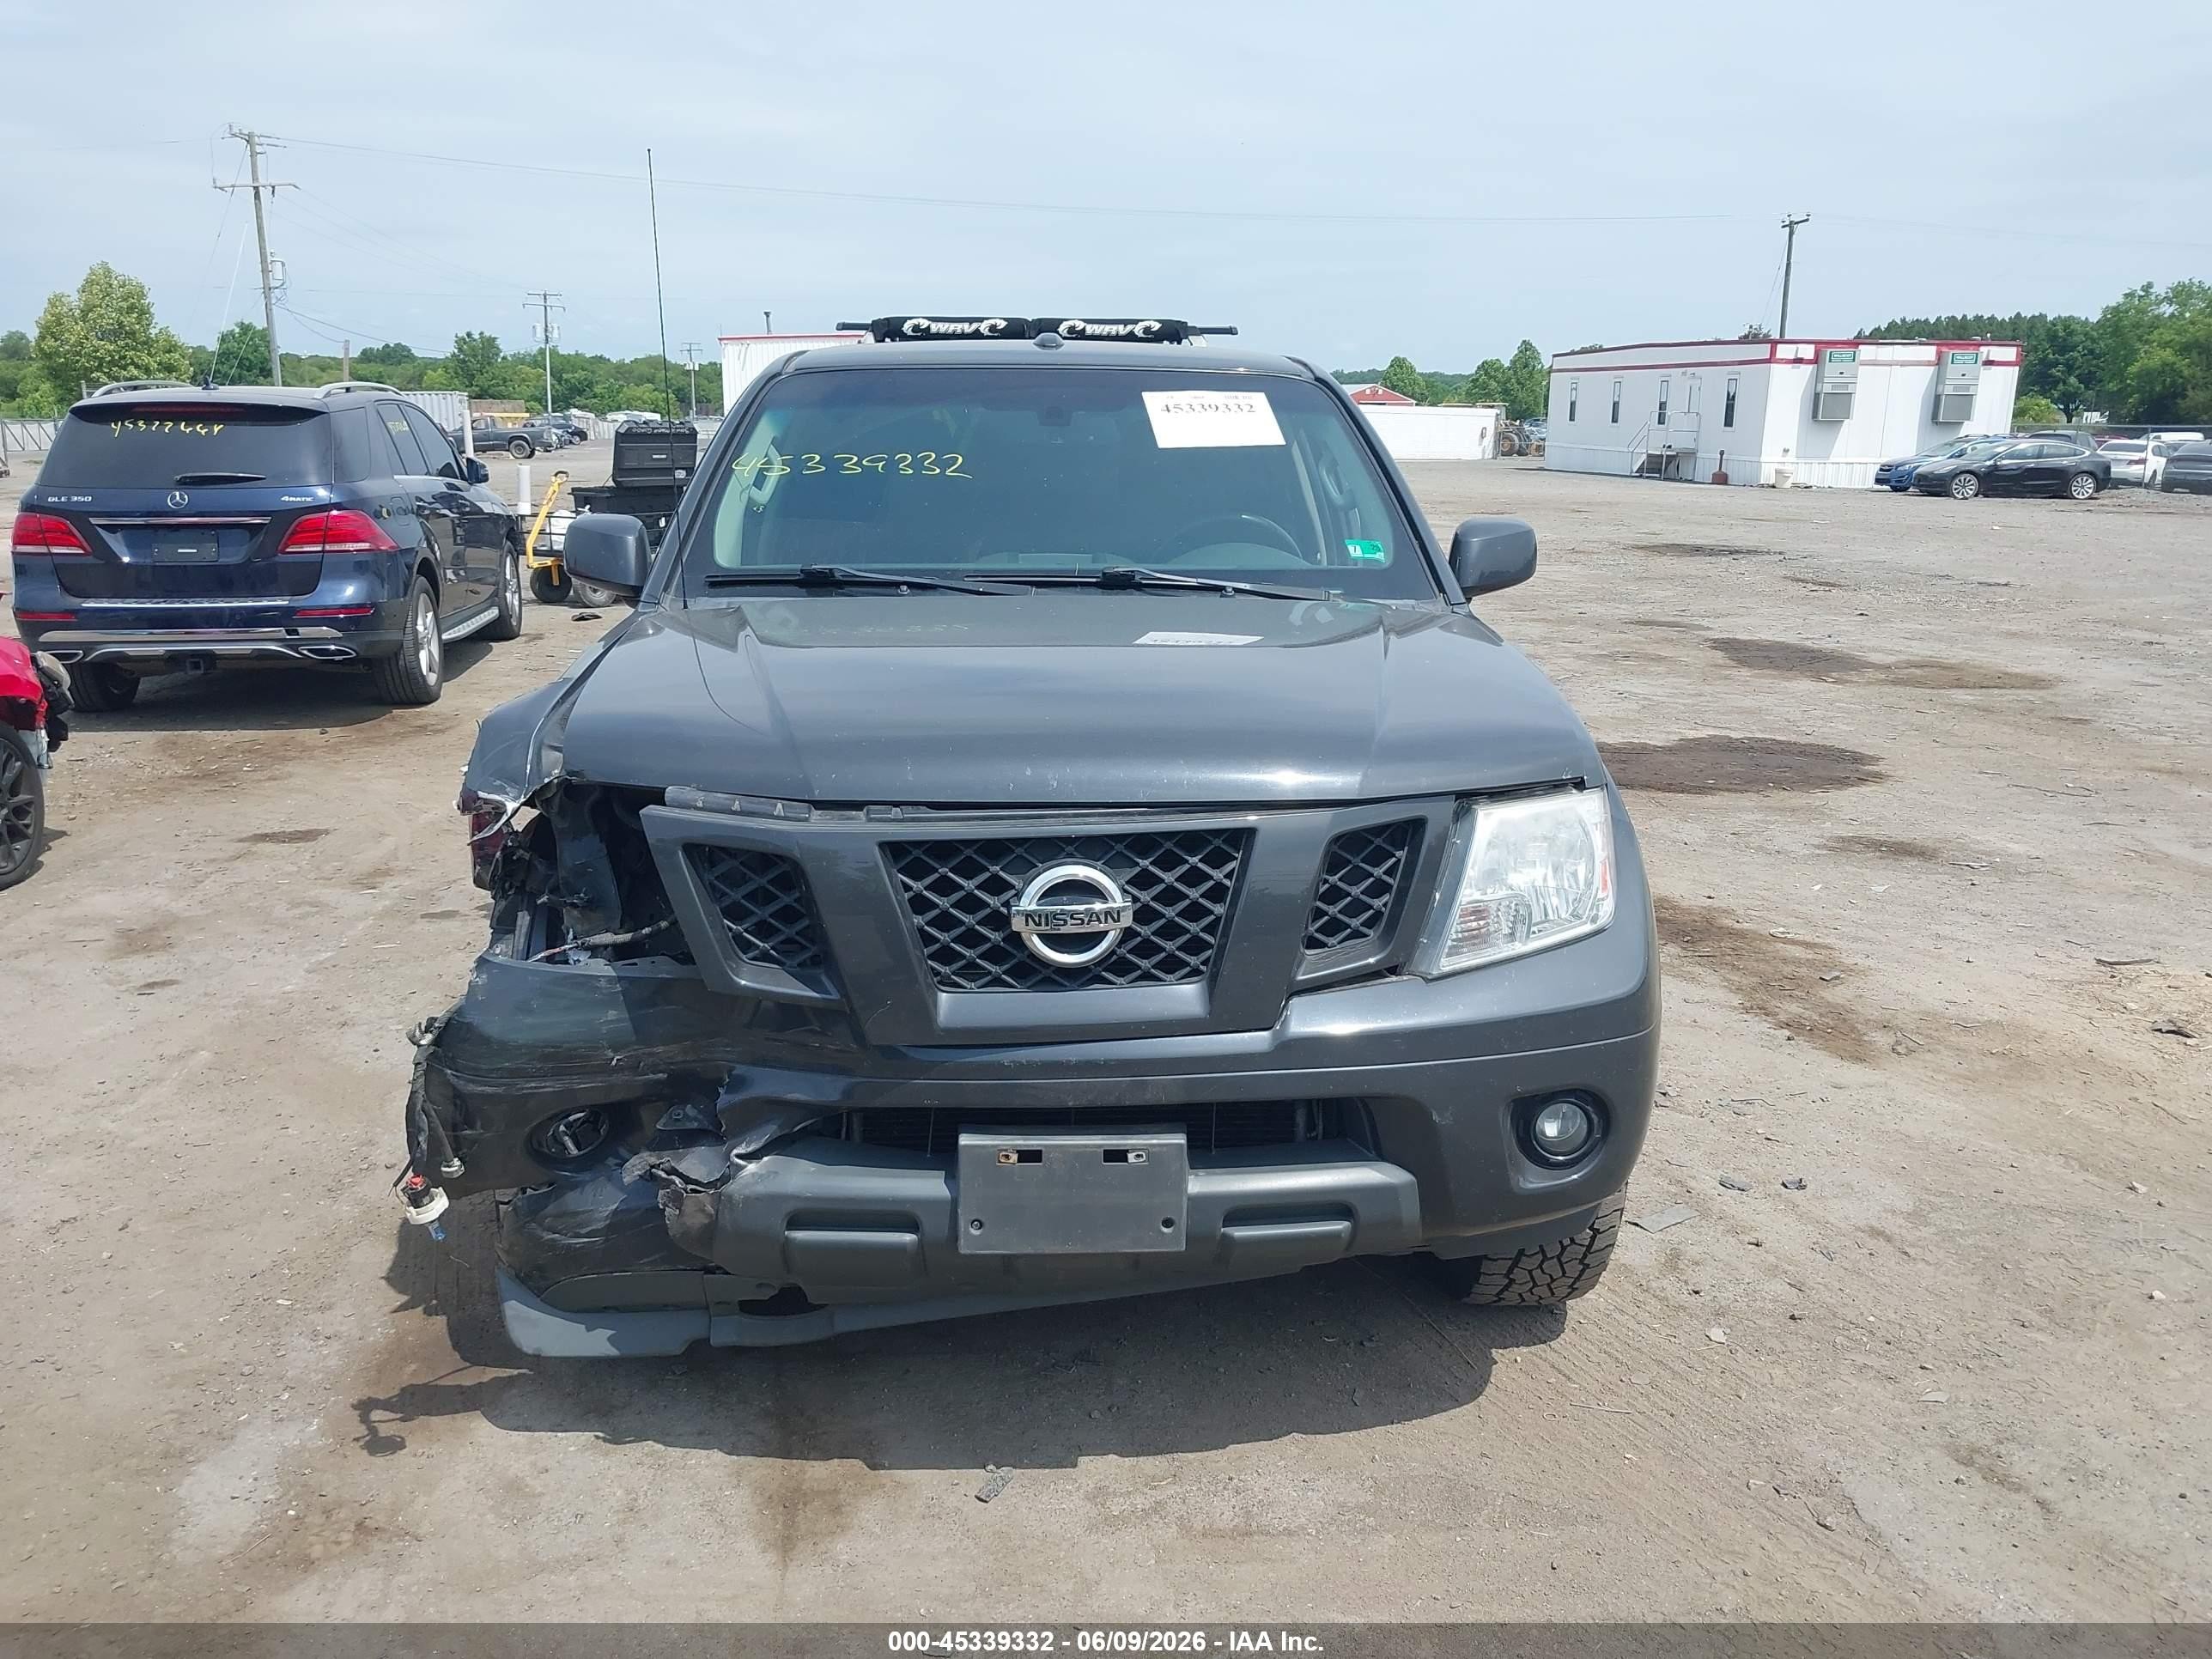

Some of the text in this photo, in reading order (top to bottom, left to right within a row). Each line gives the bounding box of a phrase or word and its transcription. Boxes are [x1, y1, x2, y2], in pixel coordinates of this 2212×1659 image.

[1161, 403, 1256, 414] 45339332
[732, 452, 974, 479] 45339332
[1024, 908, 1121, 928] NISSAN
